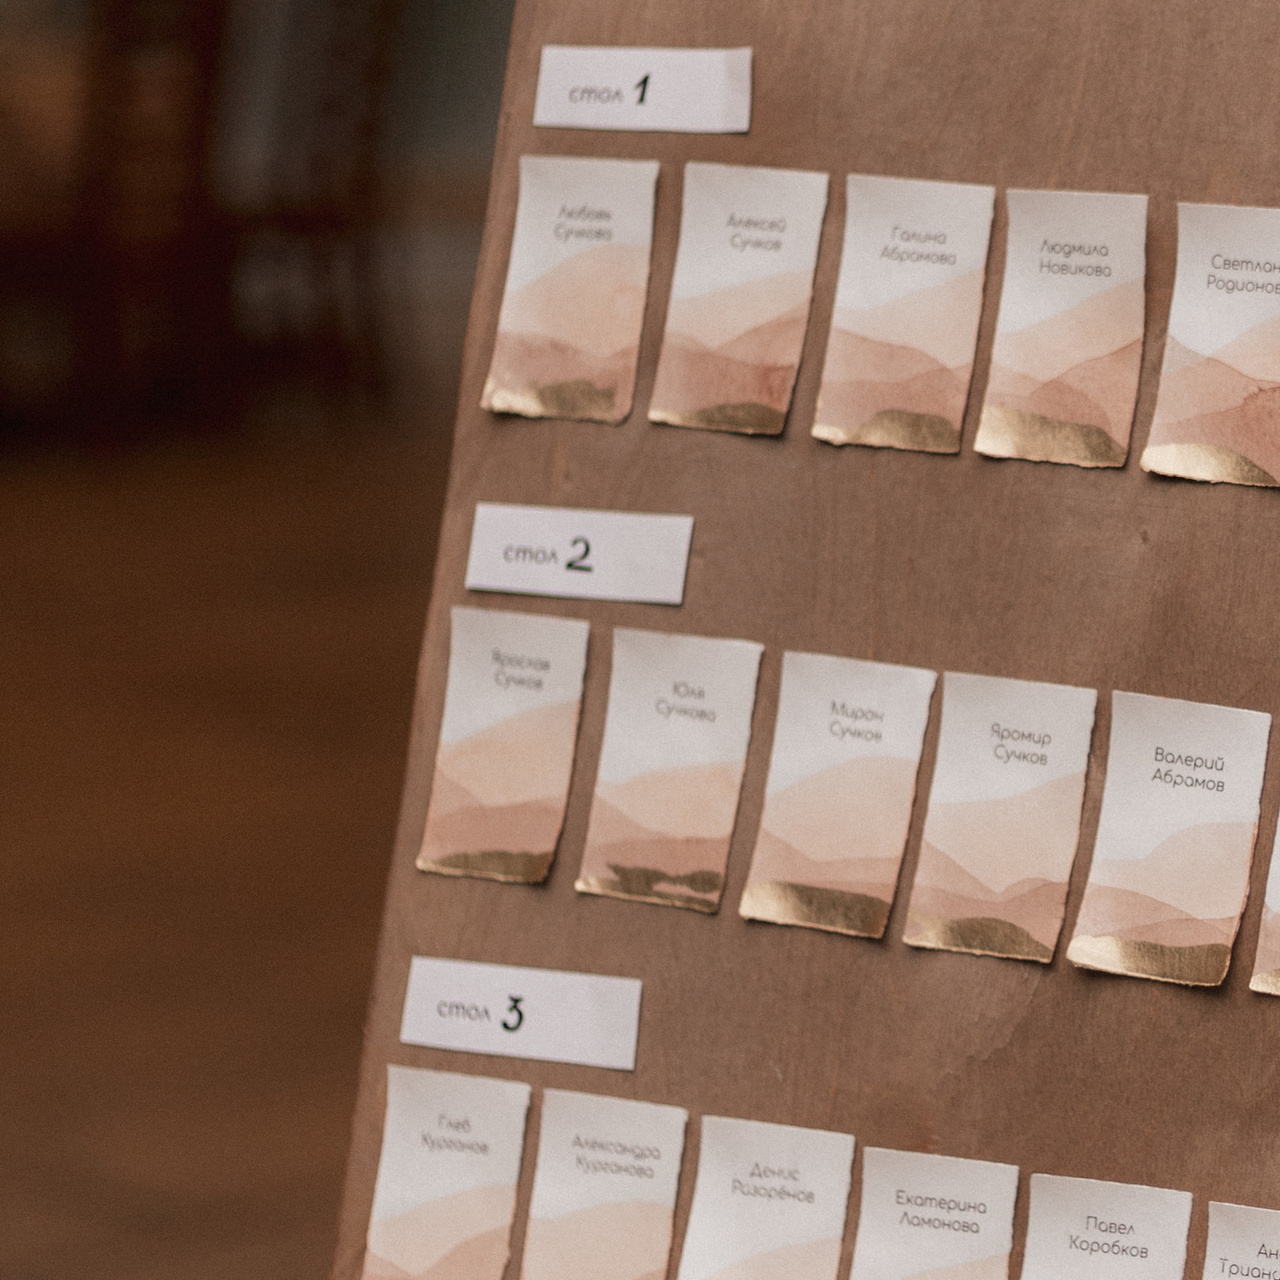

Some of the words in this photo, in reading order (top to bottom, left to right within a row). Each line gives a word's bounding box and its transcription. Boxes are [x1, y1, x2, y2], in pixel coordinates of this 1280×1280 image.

[568, 84, 624, 106] стол
[634, 73, 652, 106] 1
[892, 224, 948, 245] Галина
[879, 245, 957, 266] Абрамова
[1040, 238, 1110, 259] Людмила
[1039, 260, 1112, 278] Новикова
[503, 544, 559, 566] стол
[564, 535, 594, 574] 2
[830, 700, 885, 722] Мирон
[828, 720, 883, 743] Сучков
[990, 722, 1052, 748] Яромир
[993, 742, 1048, 766] Сучков
[1153, 745, 1225, 773] Валерий
[1151, 767, 1226, 793] Абрамов
[437, 999, 492, 1023] стол
[500, 994, 526, 1033] 3
[895, 1188, 988, 1215] Екатерина
[1085, 1214, 1135, 1236] Павел
[1068, 1234, 1149, 1260] Коробков
